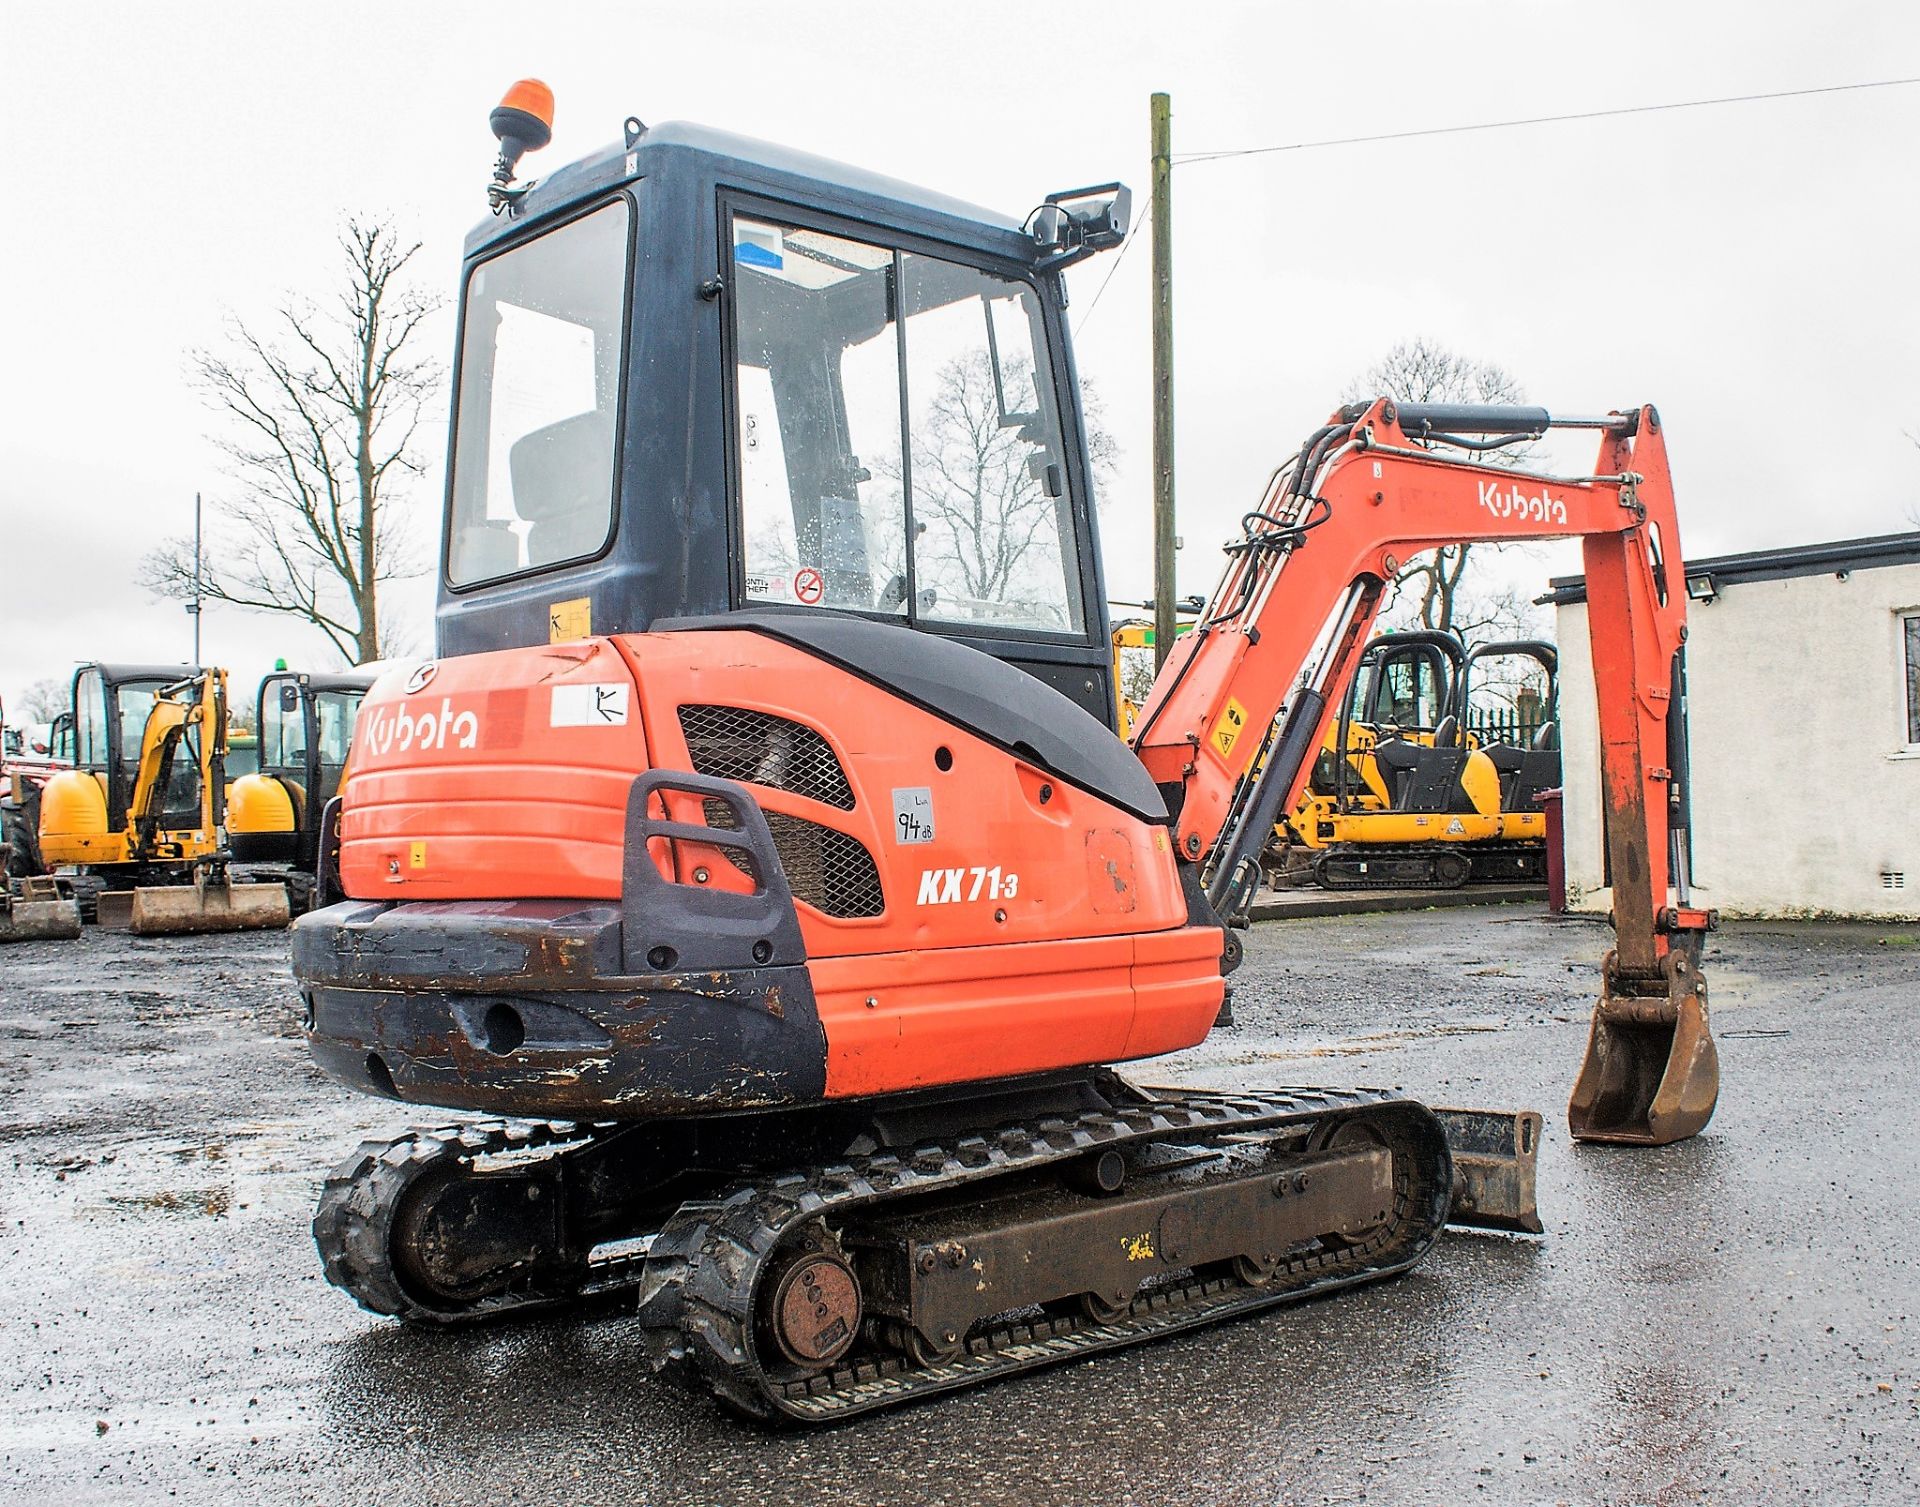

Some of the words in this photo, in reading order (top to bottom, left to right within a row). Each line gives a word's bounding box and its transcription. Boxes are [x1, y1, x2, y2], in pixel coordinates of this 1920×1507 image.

[1478, 480, 1567, 525] Kubota
[364, 698, 479, 757] Kubota
[898, 812, 921, 840] 94
[921, 824, 933, 839] dB
